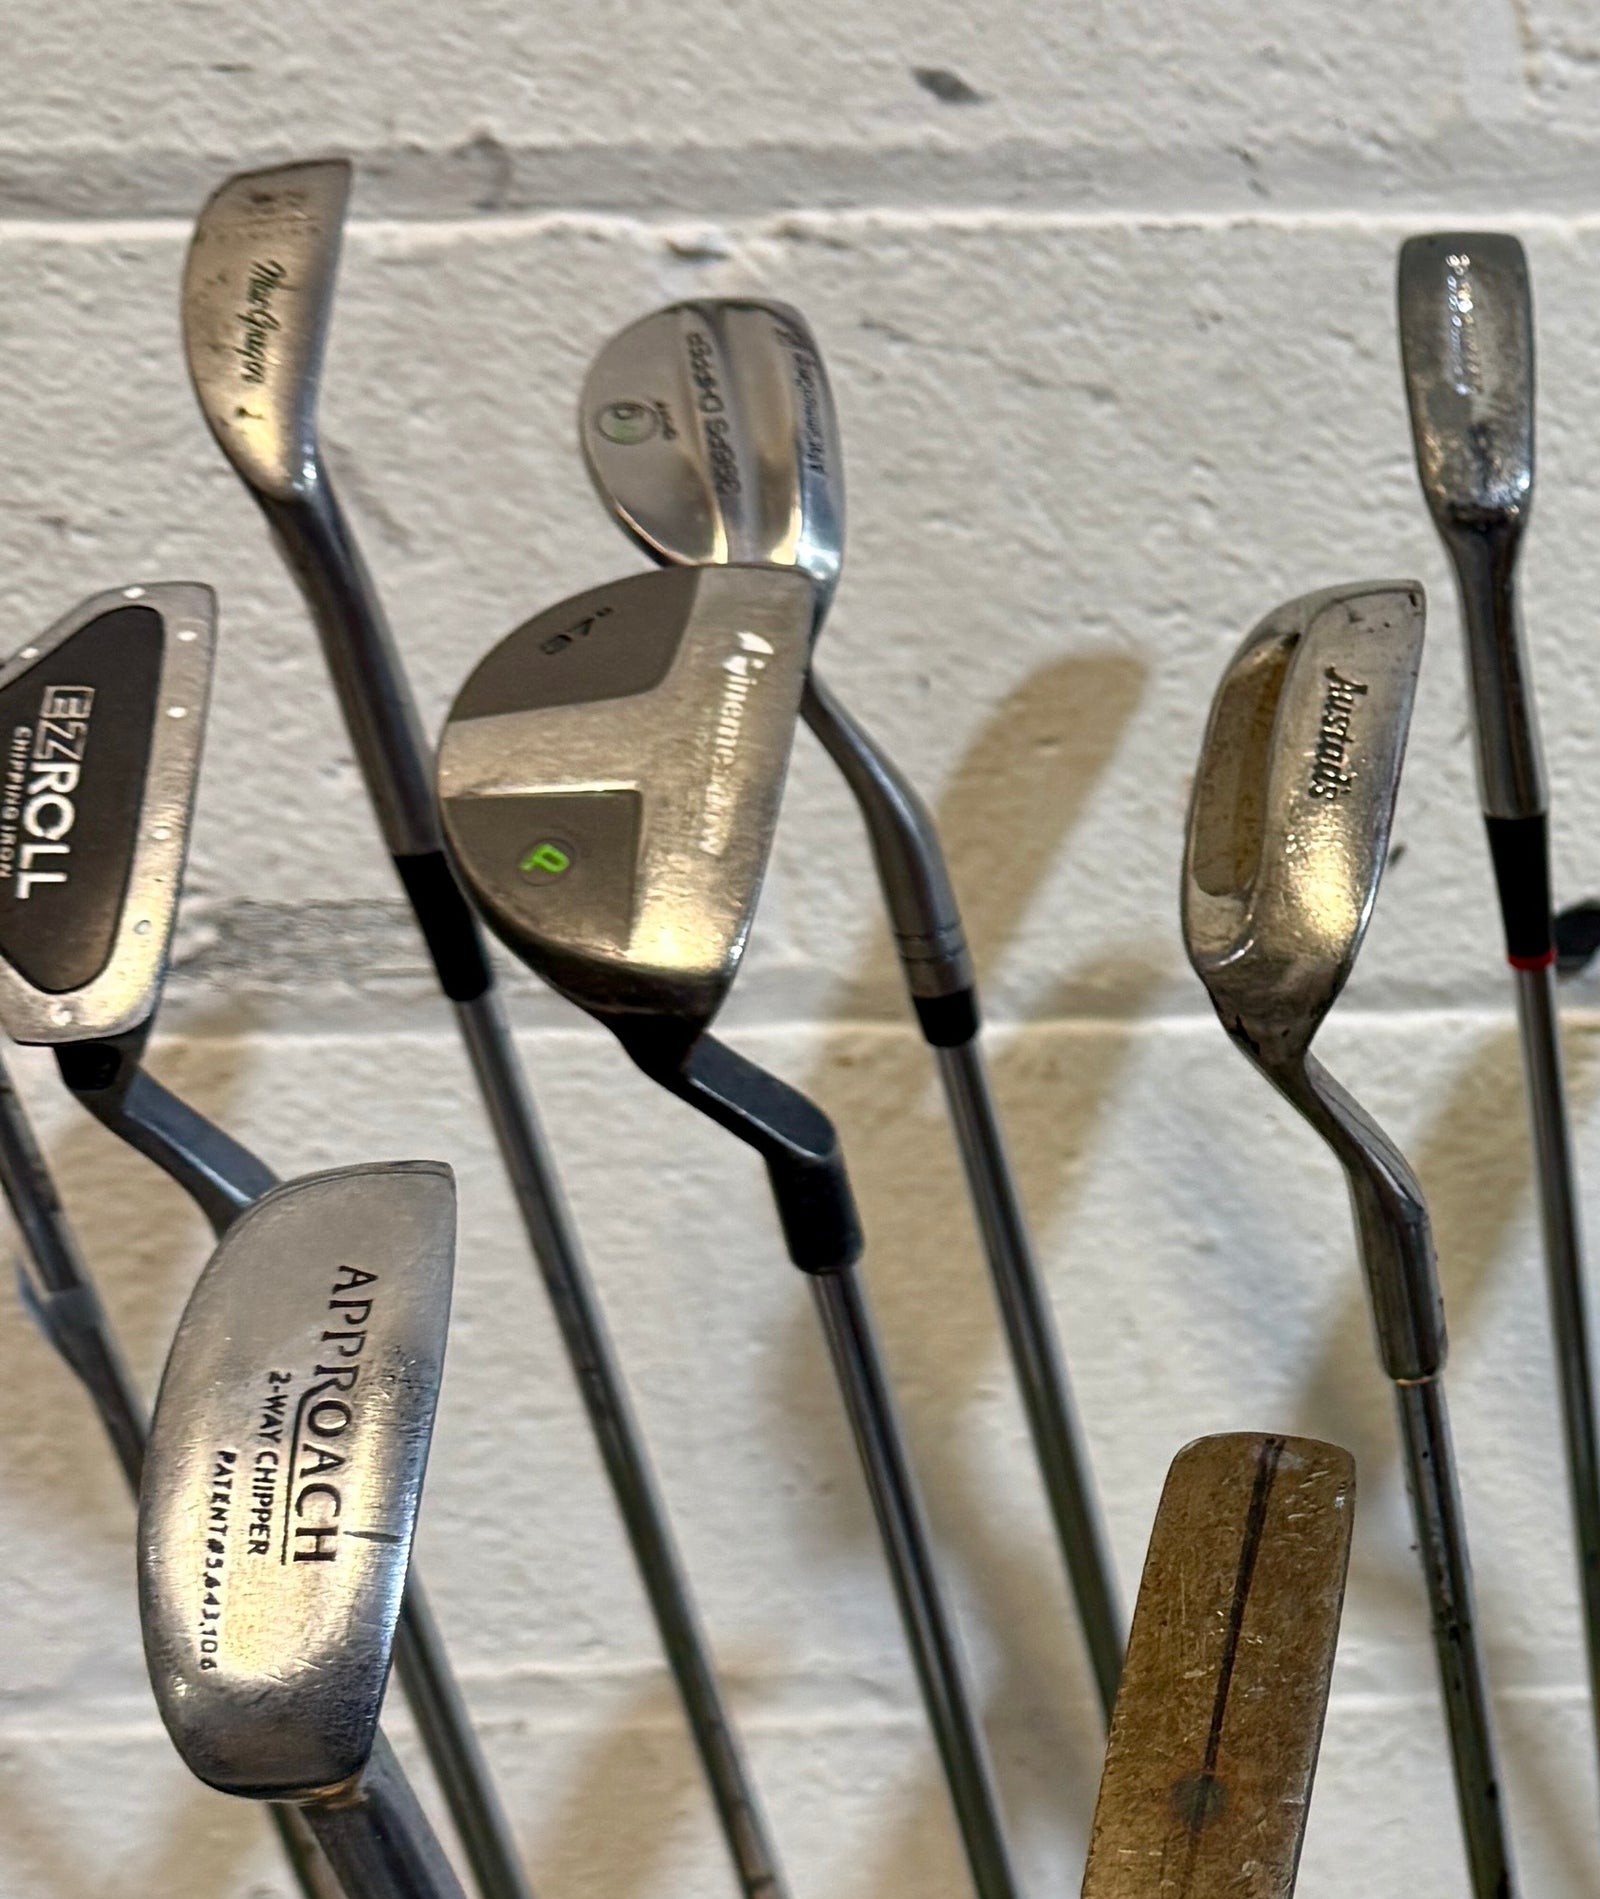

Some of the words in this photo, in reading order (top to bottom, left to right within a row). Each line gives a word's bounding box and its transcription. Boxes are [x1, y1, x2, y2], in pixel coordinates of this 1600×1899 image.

[1, 726, 33, 821] CHIPPING
[259, 1370, 292, 1444] 2-WAY
[292, 1265, 379, 1564] APPROACH
[247, 1450, 280, 1556] CHIPPER
